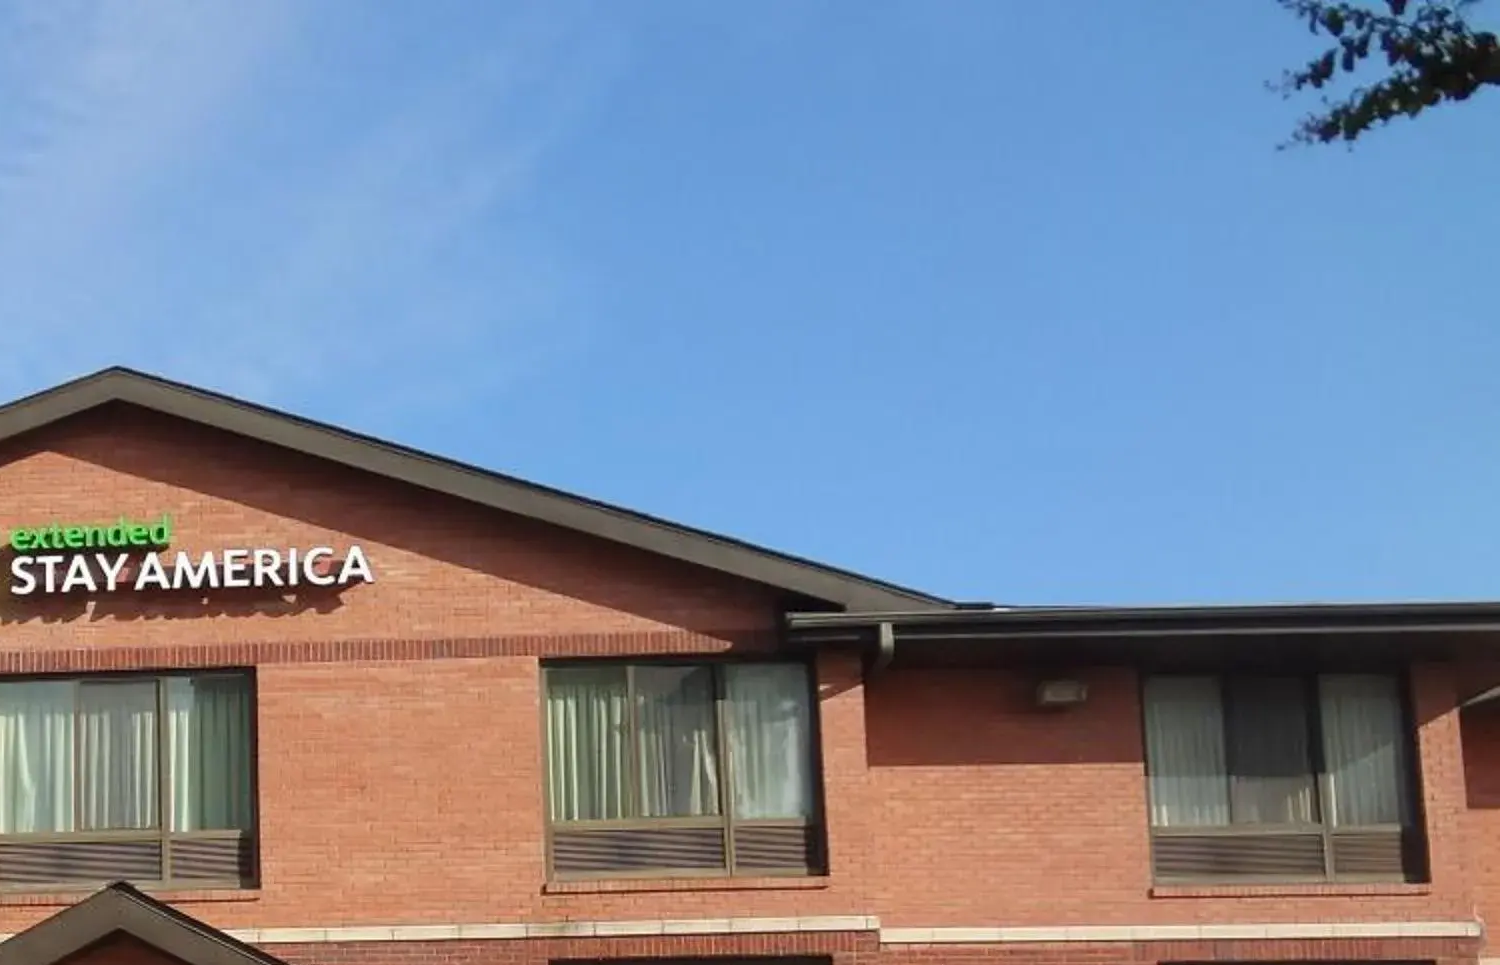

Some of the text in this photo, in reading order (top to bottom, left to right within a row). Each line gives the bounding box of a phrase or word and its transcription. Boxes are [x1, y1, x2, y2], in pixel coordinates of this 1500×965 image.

[12, 515, 171, 550] extended
[10, 545, 374, 595] STAY AMERICA
